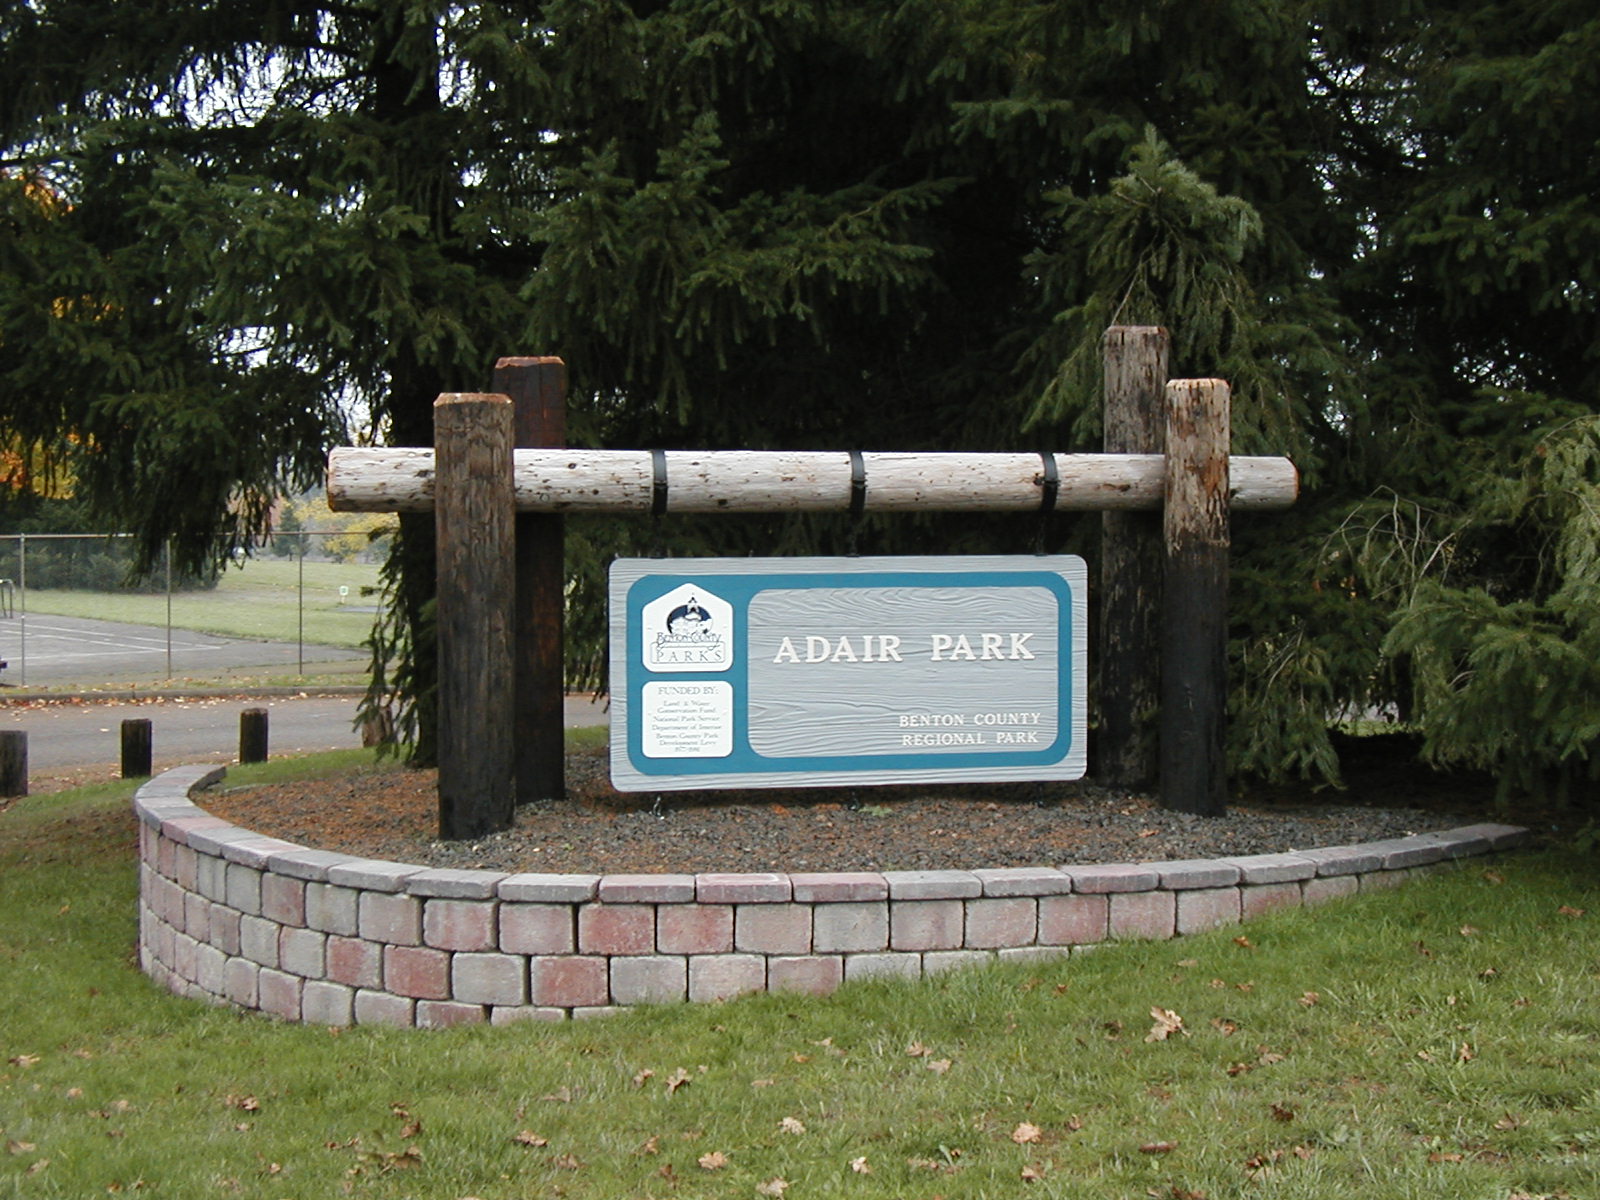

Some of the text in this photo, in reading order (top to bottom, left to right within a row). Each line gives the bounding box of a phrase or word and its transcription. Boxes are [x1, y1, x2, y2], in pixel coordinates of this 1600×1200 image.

[656, 650, 722, 662] PARKS
[773, 633, 1035, 664] ADAIR PARK
[658, 686, 701, 695] FUNDED
[899, 712, 1041, 728] BENTON COUNTY
[902, 731, 1039, 747] REGIONAL PARK
